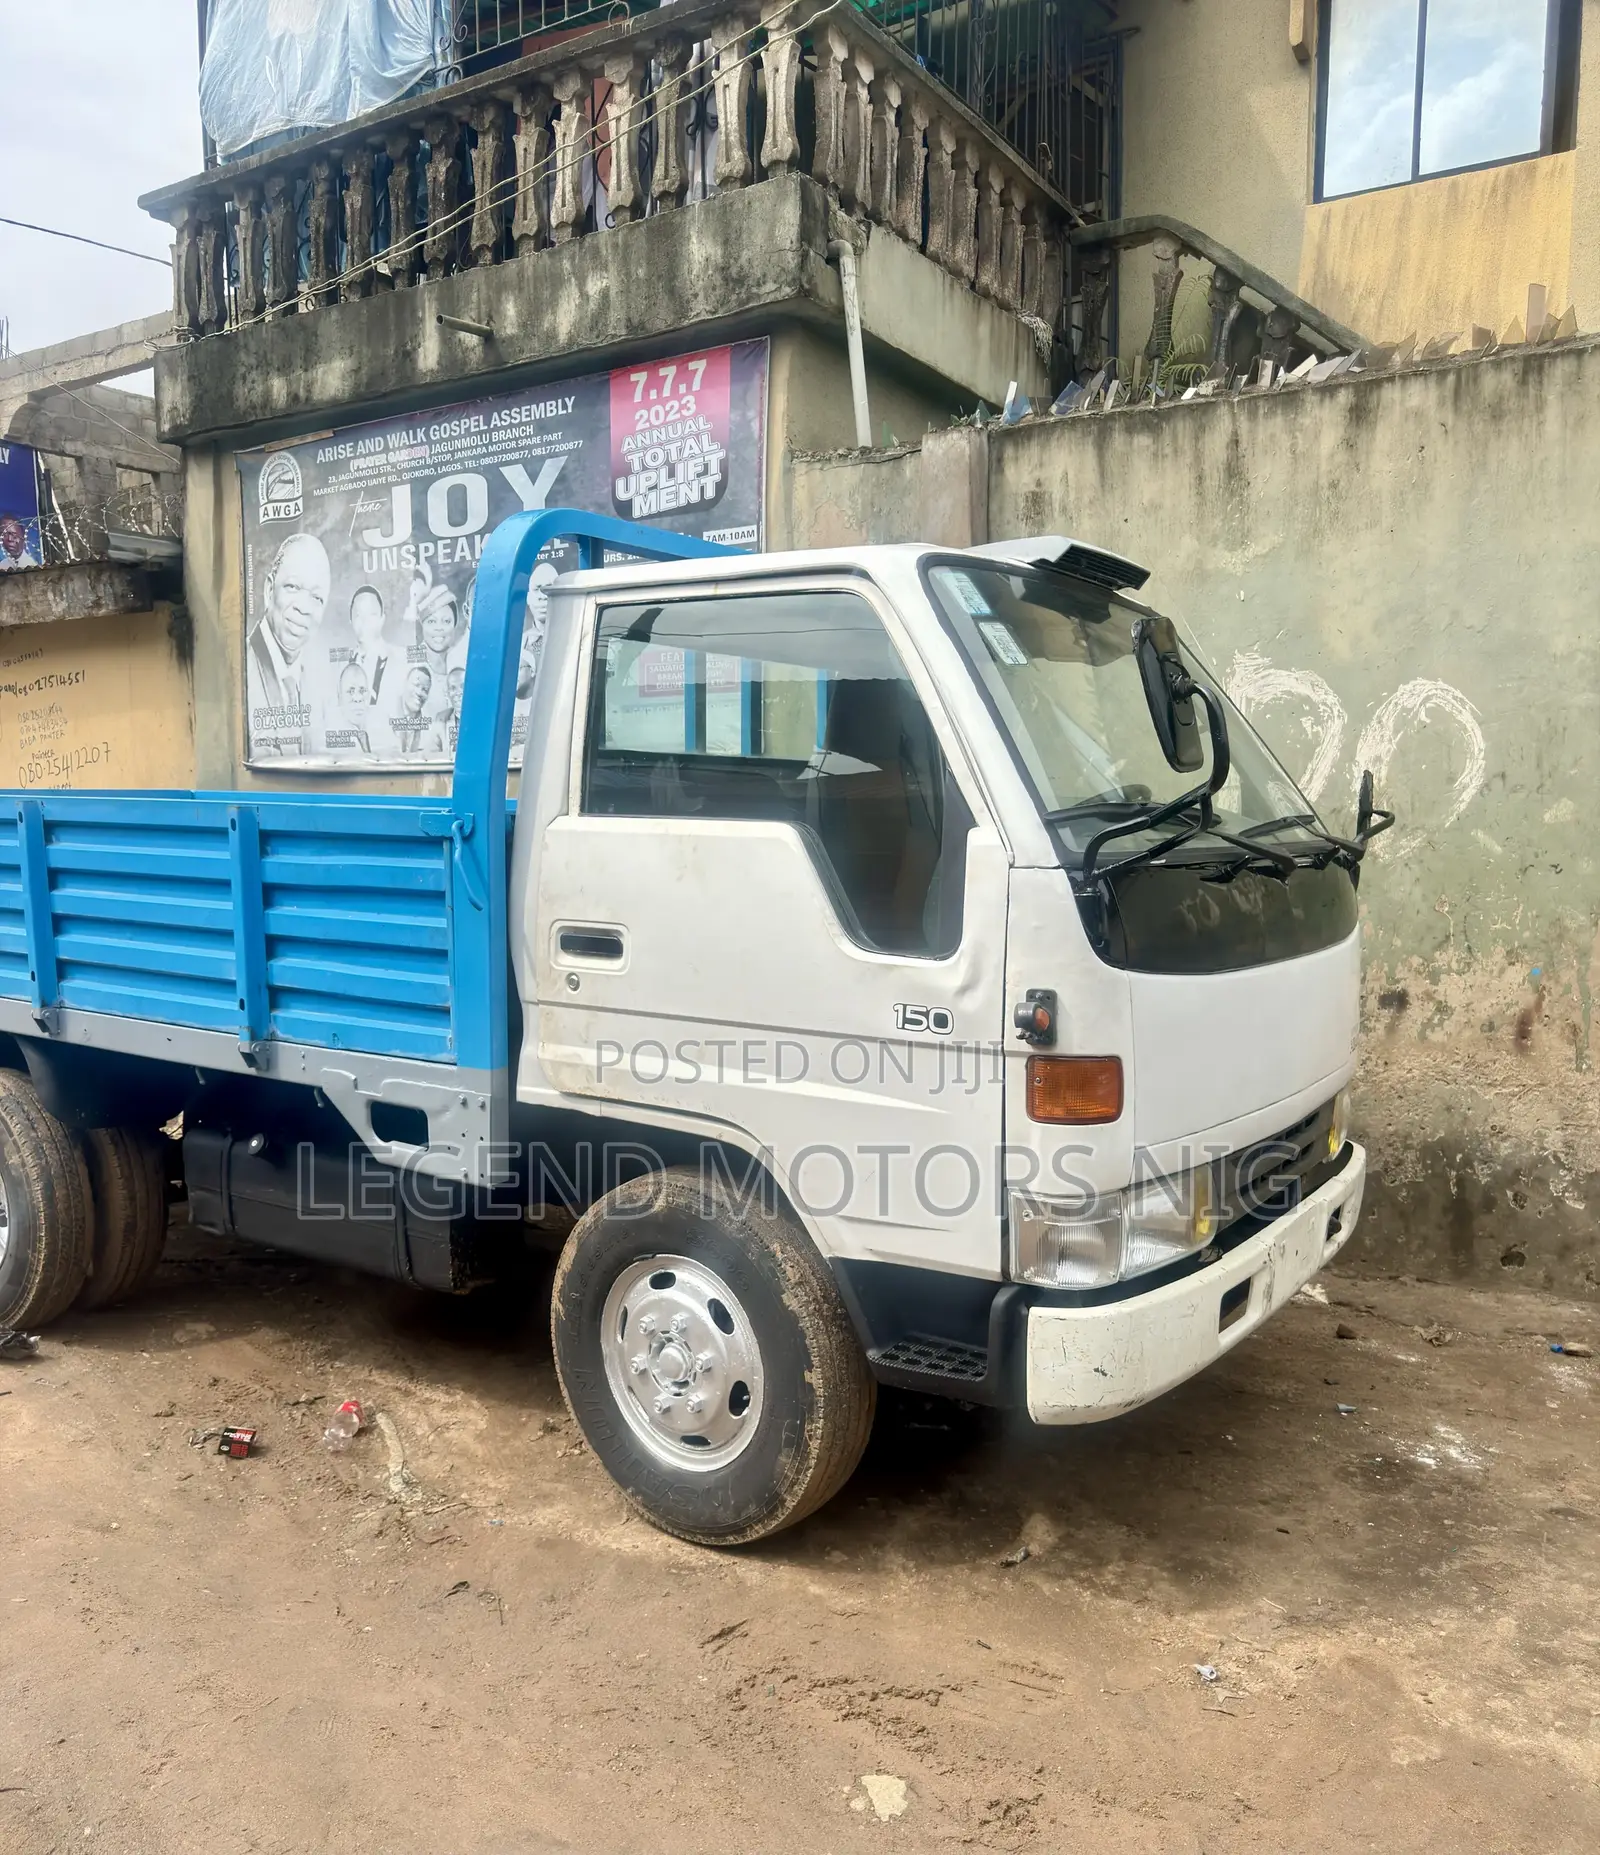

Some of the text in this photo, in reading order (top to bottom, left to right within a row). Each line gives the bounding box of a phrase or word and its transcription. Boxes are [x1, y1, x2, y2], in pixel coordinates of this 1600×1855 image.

[630, 359, 707, 403] 7.7.7
[316, 396, 575, 464] ARISE AND WALK GOSPEL ASSEMBLY
[635, 395, 696, 431] 2023
[430, 434, 490, 454] JAGUNMOLU
[492, 425, 534, 442] BRANCH
[622, 415, 712, 453] ANNUAL
[625, 431, 720, 473] TOTAL
[338, 467, 378, 482] JAGUNMOLU
[396, 459, 425, 470] CHURCH
[454, 447, 487, 459] JANKARA
[488, 441, 517, 453] MOTOR
[517, 437, 542, 448] SPARE
[543, 431, 563, 443] PART
[615, 449, 725, 500] UPLIFT
[313, 485, 339, 496] MARKET
[339, 480, 367, 492] AGBADO
[464, 459, 479, 468] TEL:
[632, 473, 721, 519] MENT
[263, 502, 301, 518] AWGA
[362, 455, 568, 548] JOY
[551, 549, 565, 559] 1:8
[706, 530, 755, 542] 7AM-10AM
[254, 712, 310, 730] OLAGOKE
[893, 1003, 954, 1035] 150
